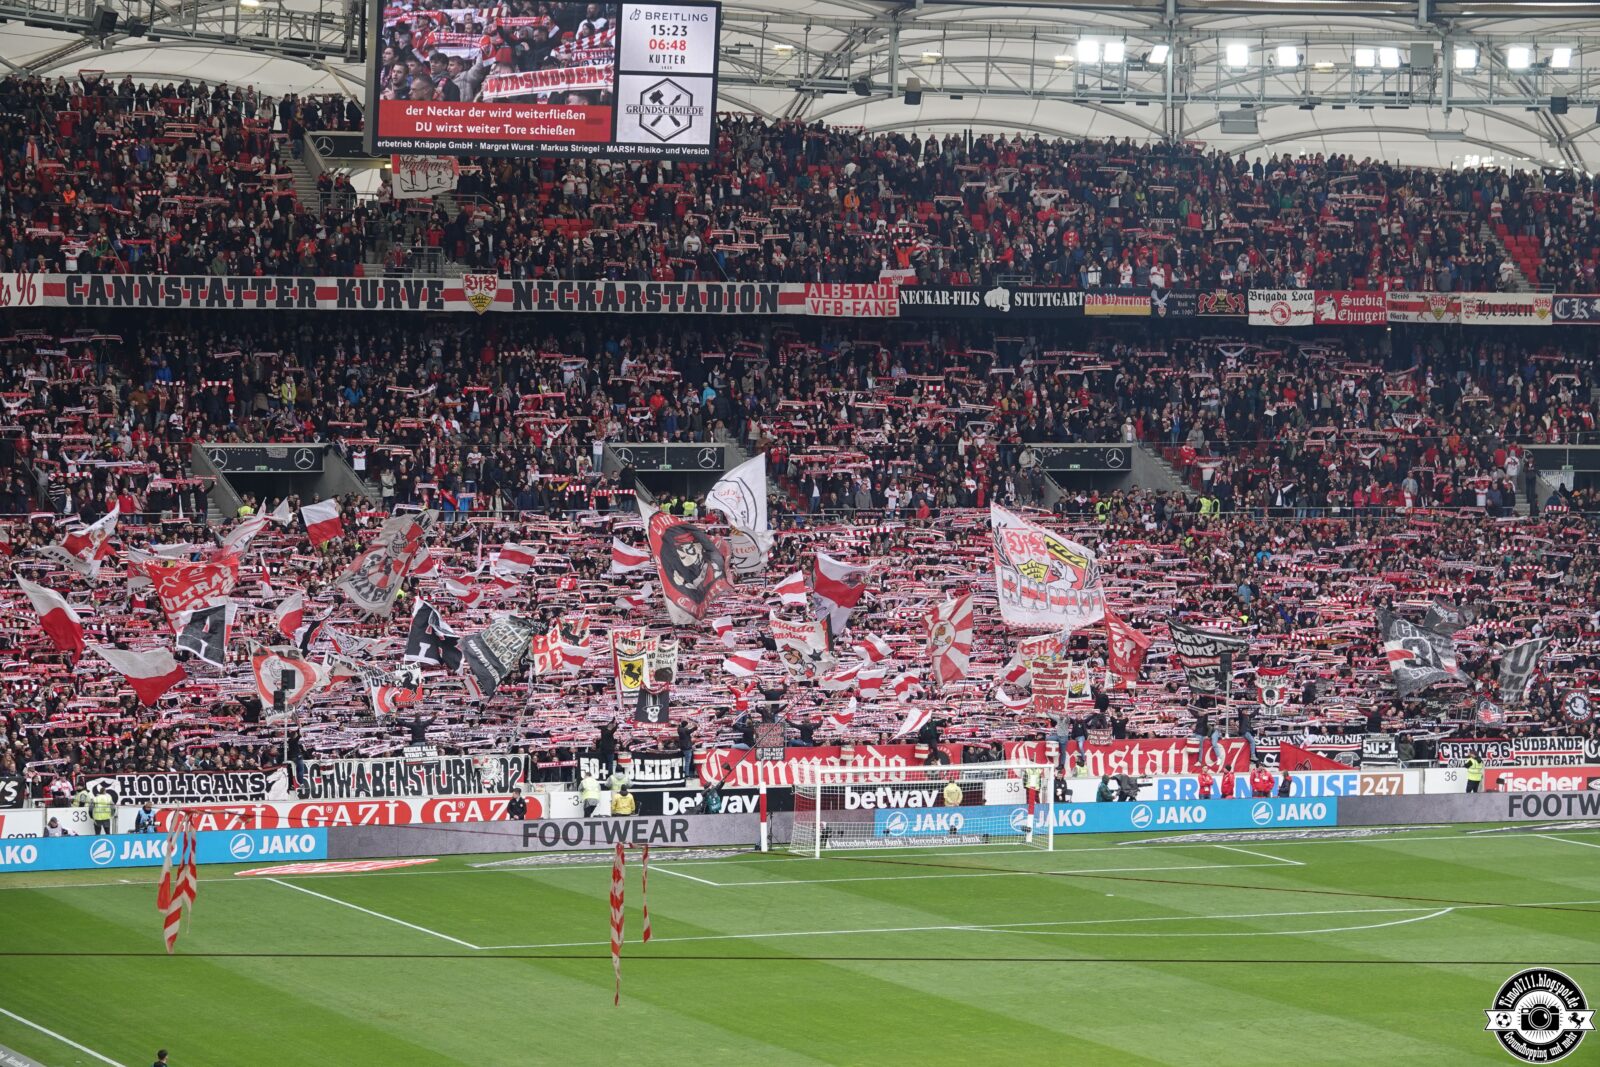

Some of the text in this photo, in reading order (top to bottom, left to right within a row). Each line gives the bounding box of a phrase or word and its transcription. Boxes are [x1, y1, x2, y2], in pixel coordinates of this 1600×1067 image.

[645, 12, 709, 22] BREITLING
[651, 25, 688, 37] 15:23
[649, 39, 687, 51] 06:48
[649, 54, 686, 65] KUTTER
[487, 66, 598, 93] WIR SIND DER
[406, 105, 586, 121] der Neckar der wird weiterfließen
[625, 105, 704, 116] GRUNDSCHMIEDE
[416, 121, 576, 137] DU wirst weiter Tore schießen
[377, 140, 710, 156] erbetrieb Knäpple GmbH Margret Wurst Markus Striegel MARSH Risiko- und Versich
[16, 271, 37, 305] 96
[65, 274, 444, 311] CANNSTATTER KURVE
[808, 284, 898, 300] ALBSTADT
[512, 280, 780, 314] NECKARSTADION
[900, 290, 980, 307] NECKAR-FILS
[1014, 290, 1086, 308] STUTTGART
[1085, 293, 1151, 308] Old Warriors
[1249, 291, 1313, 302] Brigada Loca
[1340, 294, 1384, 307] Suebia
[810, 299, 898, 317] VFB-FANS
[1337, 309, 1386, 323] Ehingen
[1475, 298, 1534, 319] Hessen
[1363, 740, 1398, 754] 50+1
[1439, 741, 1511, 759] CREW 36
[1514, 736, 1583, 751] SÜDBANDE
[1514, 754, 1584, 767] STUTTGART
[298, 757, 482, 798] SCHWABENSTURM
[1444, 771, 1458, 782] 36
[1498, 772, 1583, 792] fischer
[117, 774, 266, 798] HOOLIGANS
[1006, 782, 1020, 793] 35
[1362, 777, 1400, 796] 247
[72, 811, 88, 823] 33
[1157, 805, 1207, 825] JAKO
[1277, 802, 1327, 821] JAKO
[912, 812, 964, 832] JAKO
[522, 818, 690, 848] FOOTWEAR
[908, 834, 981, 845] Mercedes-Benz Bank
[120, 838, 178, 860] JAKO
[259, 834, 316, 855] JAKO
